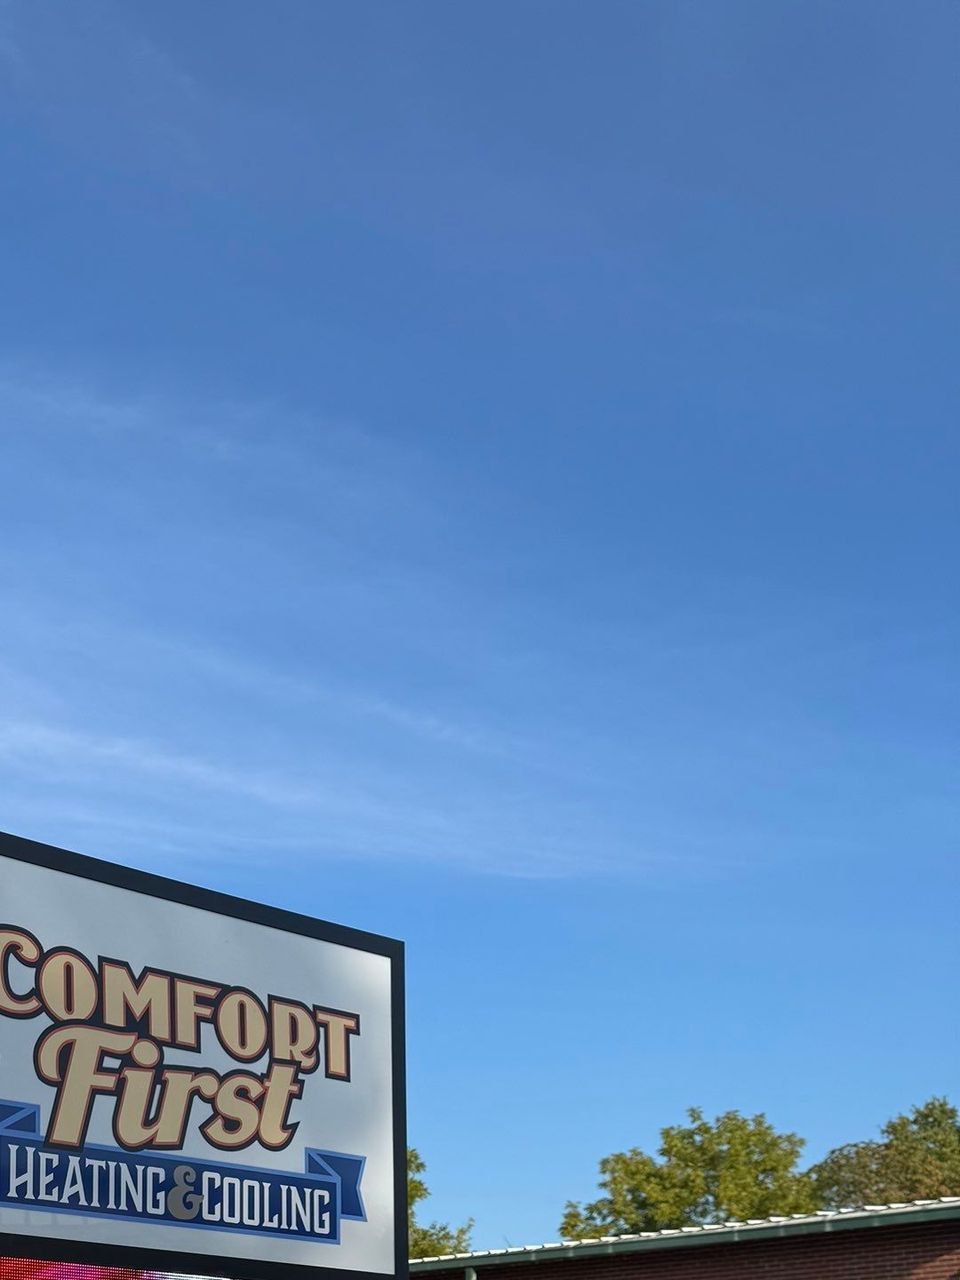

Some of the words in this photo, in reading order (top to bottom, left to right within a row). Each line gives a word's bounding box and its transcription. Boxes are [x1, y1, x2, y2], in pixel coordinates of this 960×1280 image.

[34, 1019, 305, 1151] First
[7, 1144, 165, 1215] HEATING
[202, 1170, 330, 1235] COOLING
